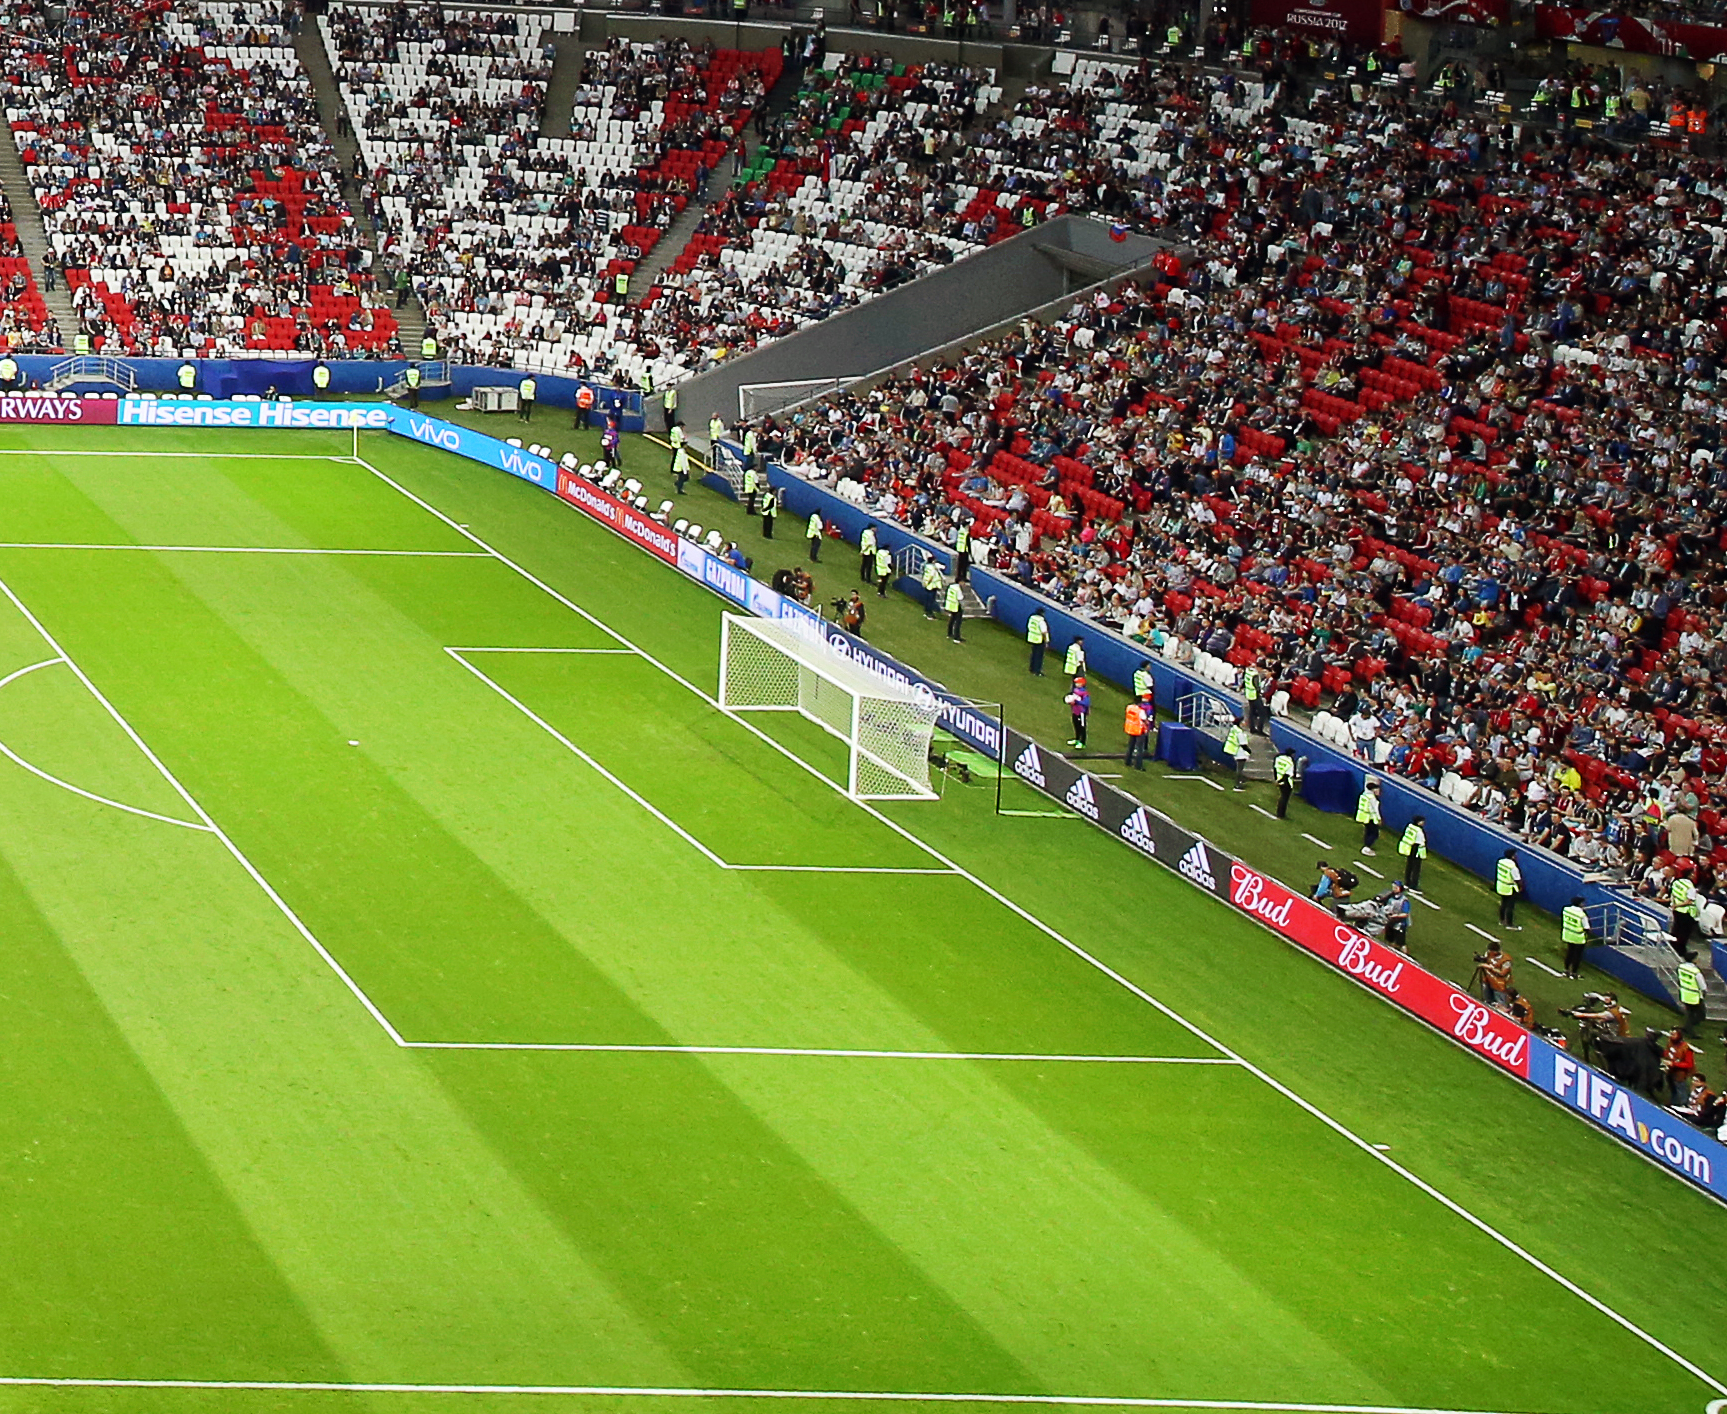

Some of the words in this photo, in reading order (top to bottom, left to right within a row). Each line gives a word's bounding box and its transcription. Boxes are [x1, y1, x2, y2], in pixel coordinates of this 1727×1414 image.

[1286, 13, 1323, 27] RUSSIA
[1324, 18, 1348, 31] 2017
[123, 400, 252, 424] Hisense
[259, 402, 388, 427] Hisense
[410, 418, 461, 451] vivo
[499, 448, 543, 483] vivo
[568, 479, 616, 521] McDonald's
[624, 513, 677, 558] McDonald's
[705, 558, 746, 602] GAZPROM
[852, 646, 910, 696] HYUNDAI
[937, 696, 1001, 752] HYUNDAI
[1014, 757, 1046, 788] adidas
[1066, 789, 1099, 821] adidas
[1121, 822, 1156, 855] adidas
[1178, 858, 1216, 891] adidas
[1230, 865, 1294, 928] Bud
[1334, 925, 1405, 995] Bud
[1449, 993, 1528, 1067] Bud
[1554, 1052, 1713, 1186] FIFA.com
